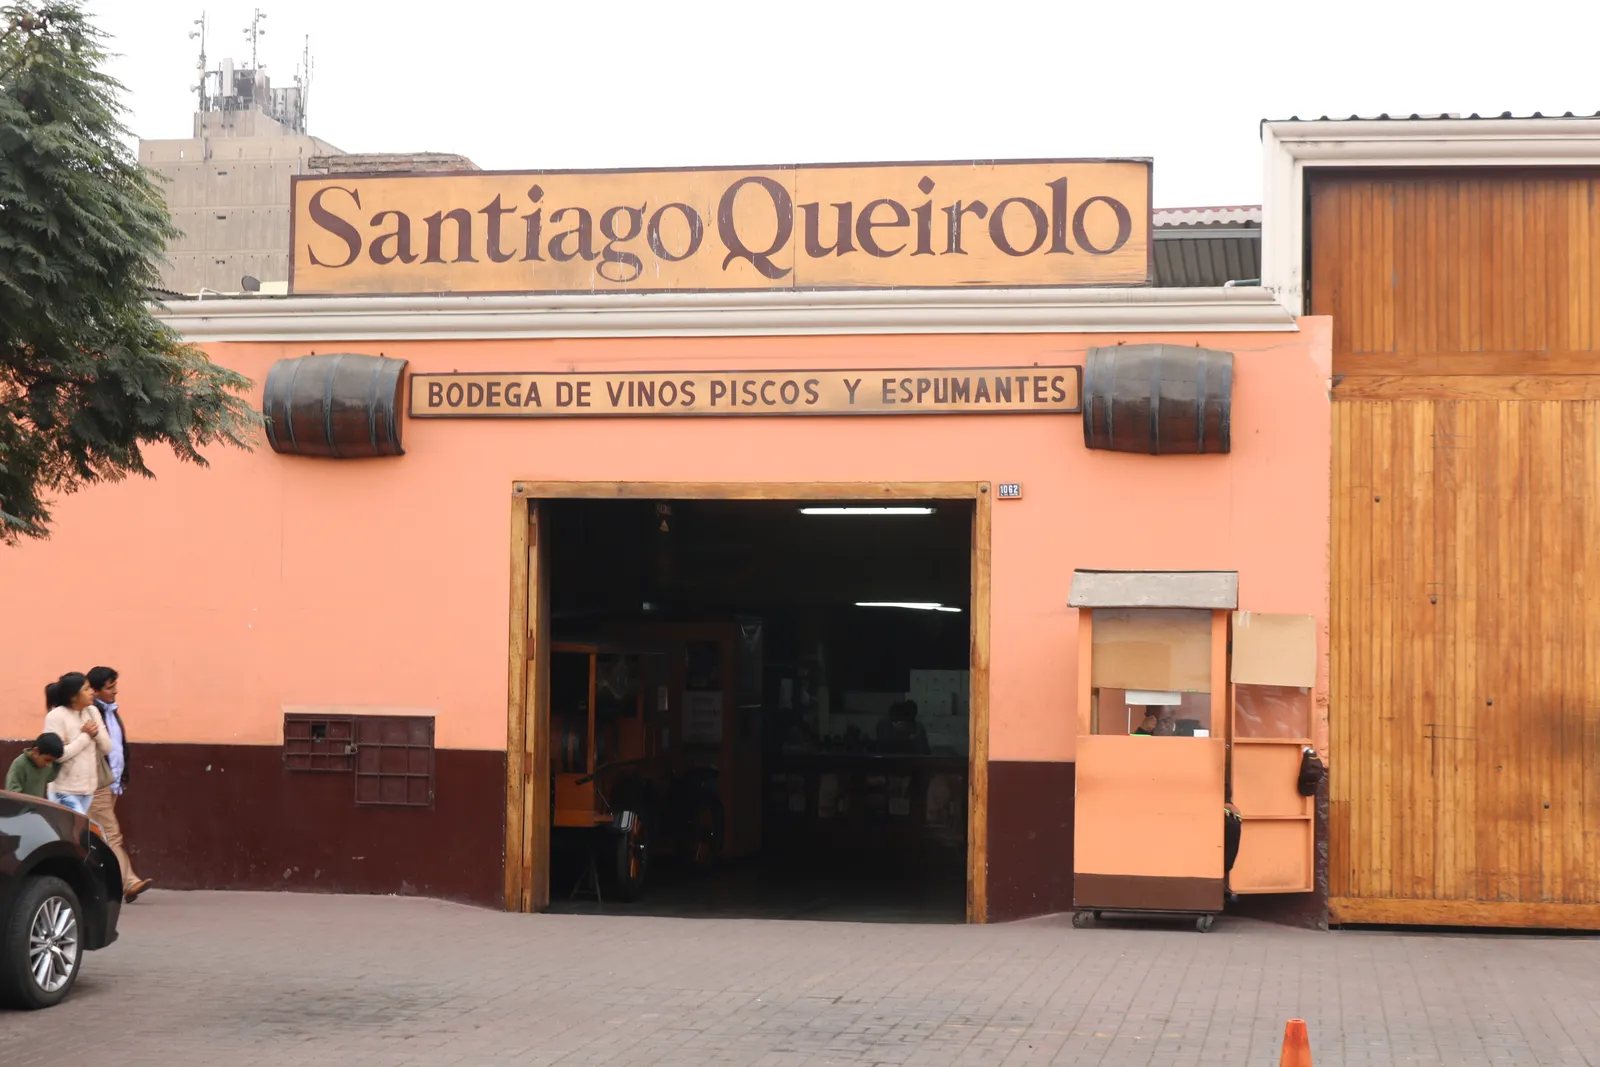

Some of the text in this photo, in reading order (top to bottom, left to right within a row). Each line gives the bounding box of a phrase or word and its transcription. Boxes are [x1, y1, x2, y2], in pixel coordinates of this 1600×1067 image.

[307, 175, 1132, 282] Santiago Queirolo
[428, 375, 1066, 408] BODEGA DE VINOS PISCOS Y ESPUMANTES
[1000, 484, 1018, 494] 1062
